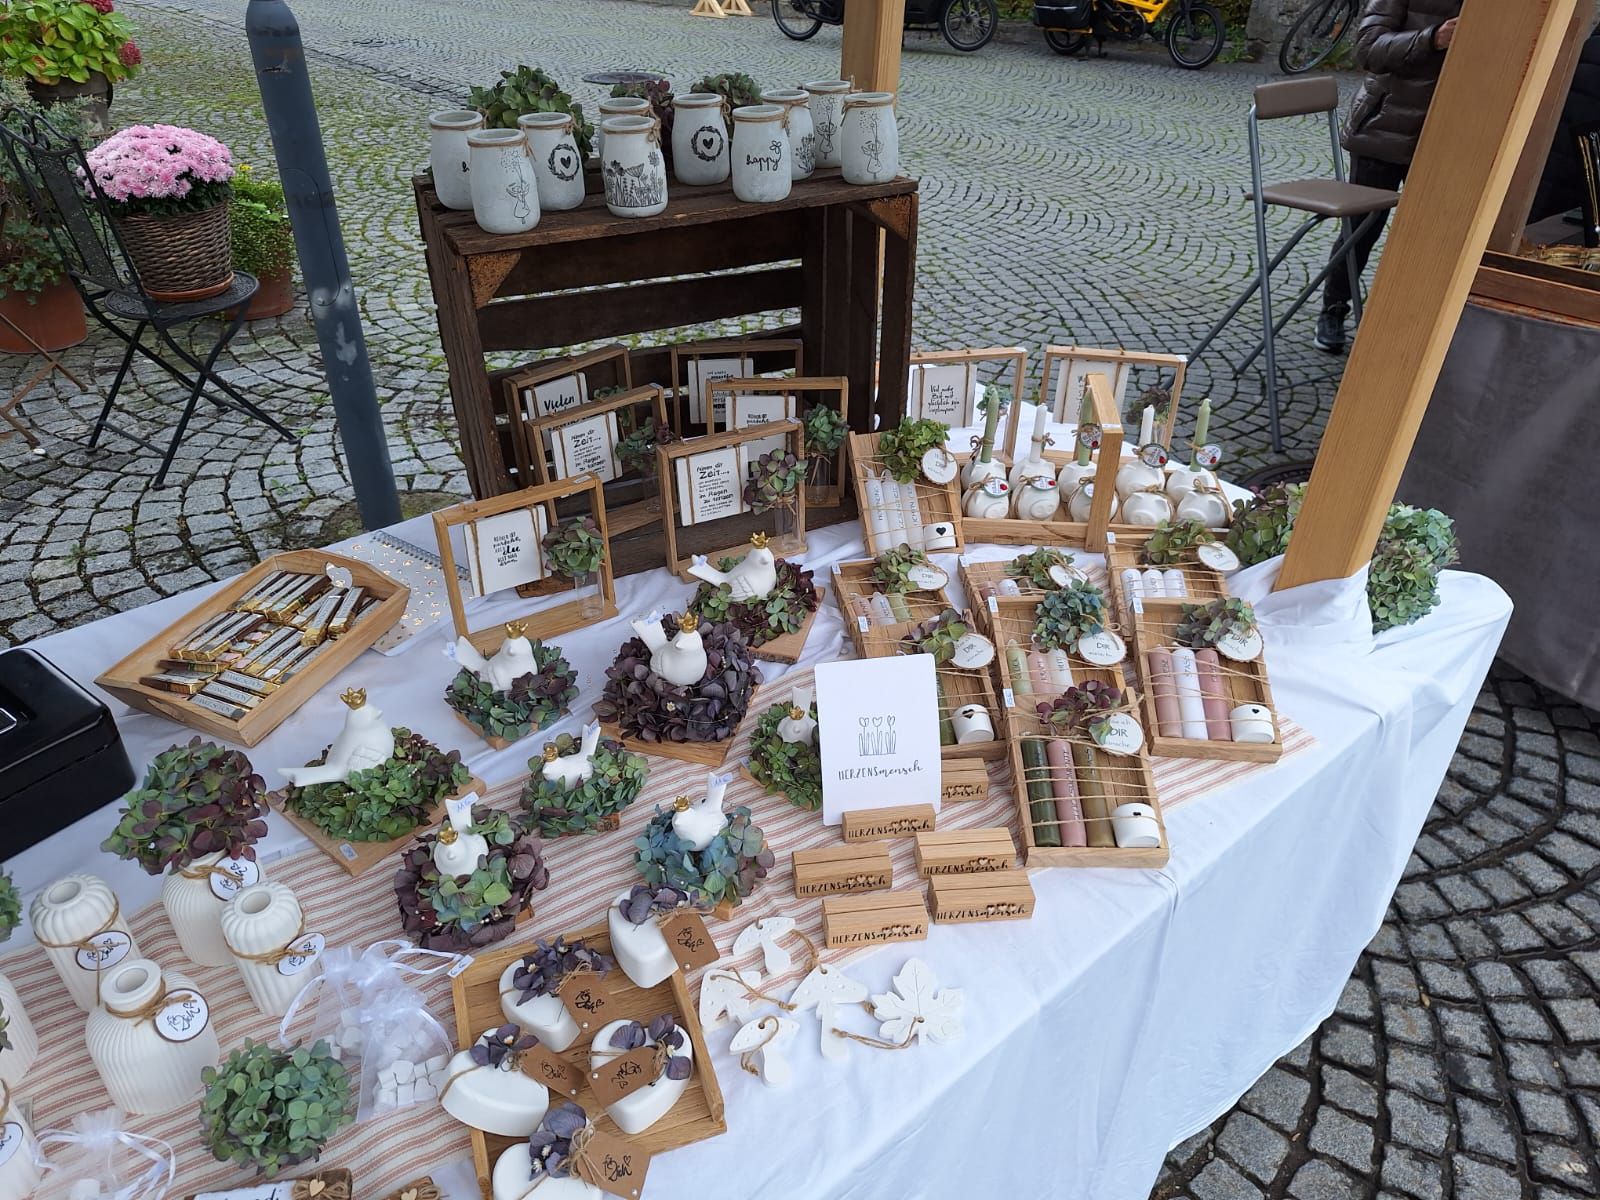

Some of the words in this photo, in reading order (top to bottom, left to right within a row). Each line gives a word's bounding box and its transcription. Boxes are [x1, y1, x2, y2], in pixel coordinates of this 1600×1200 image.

[746, 154, 781, 171] happy
[544, 394, 575, 411] Vielen
[1110, 728, 1129, 738] DIR
[838, 759, 924, 781] HERZENSmensch
[848, 821, 933, 839] HERZENSmensch
[923, 860, 1009, 876] HERZENSmensch
[799, 876, 887, 895] HERZENSmensch
[936, 904, 1028, 921] HERZENSmensch
[831, 926, 924, 945] HERZENSmensch
[606, 1159, 633, 1182] Dich
